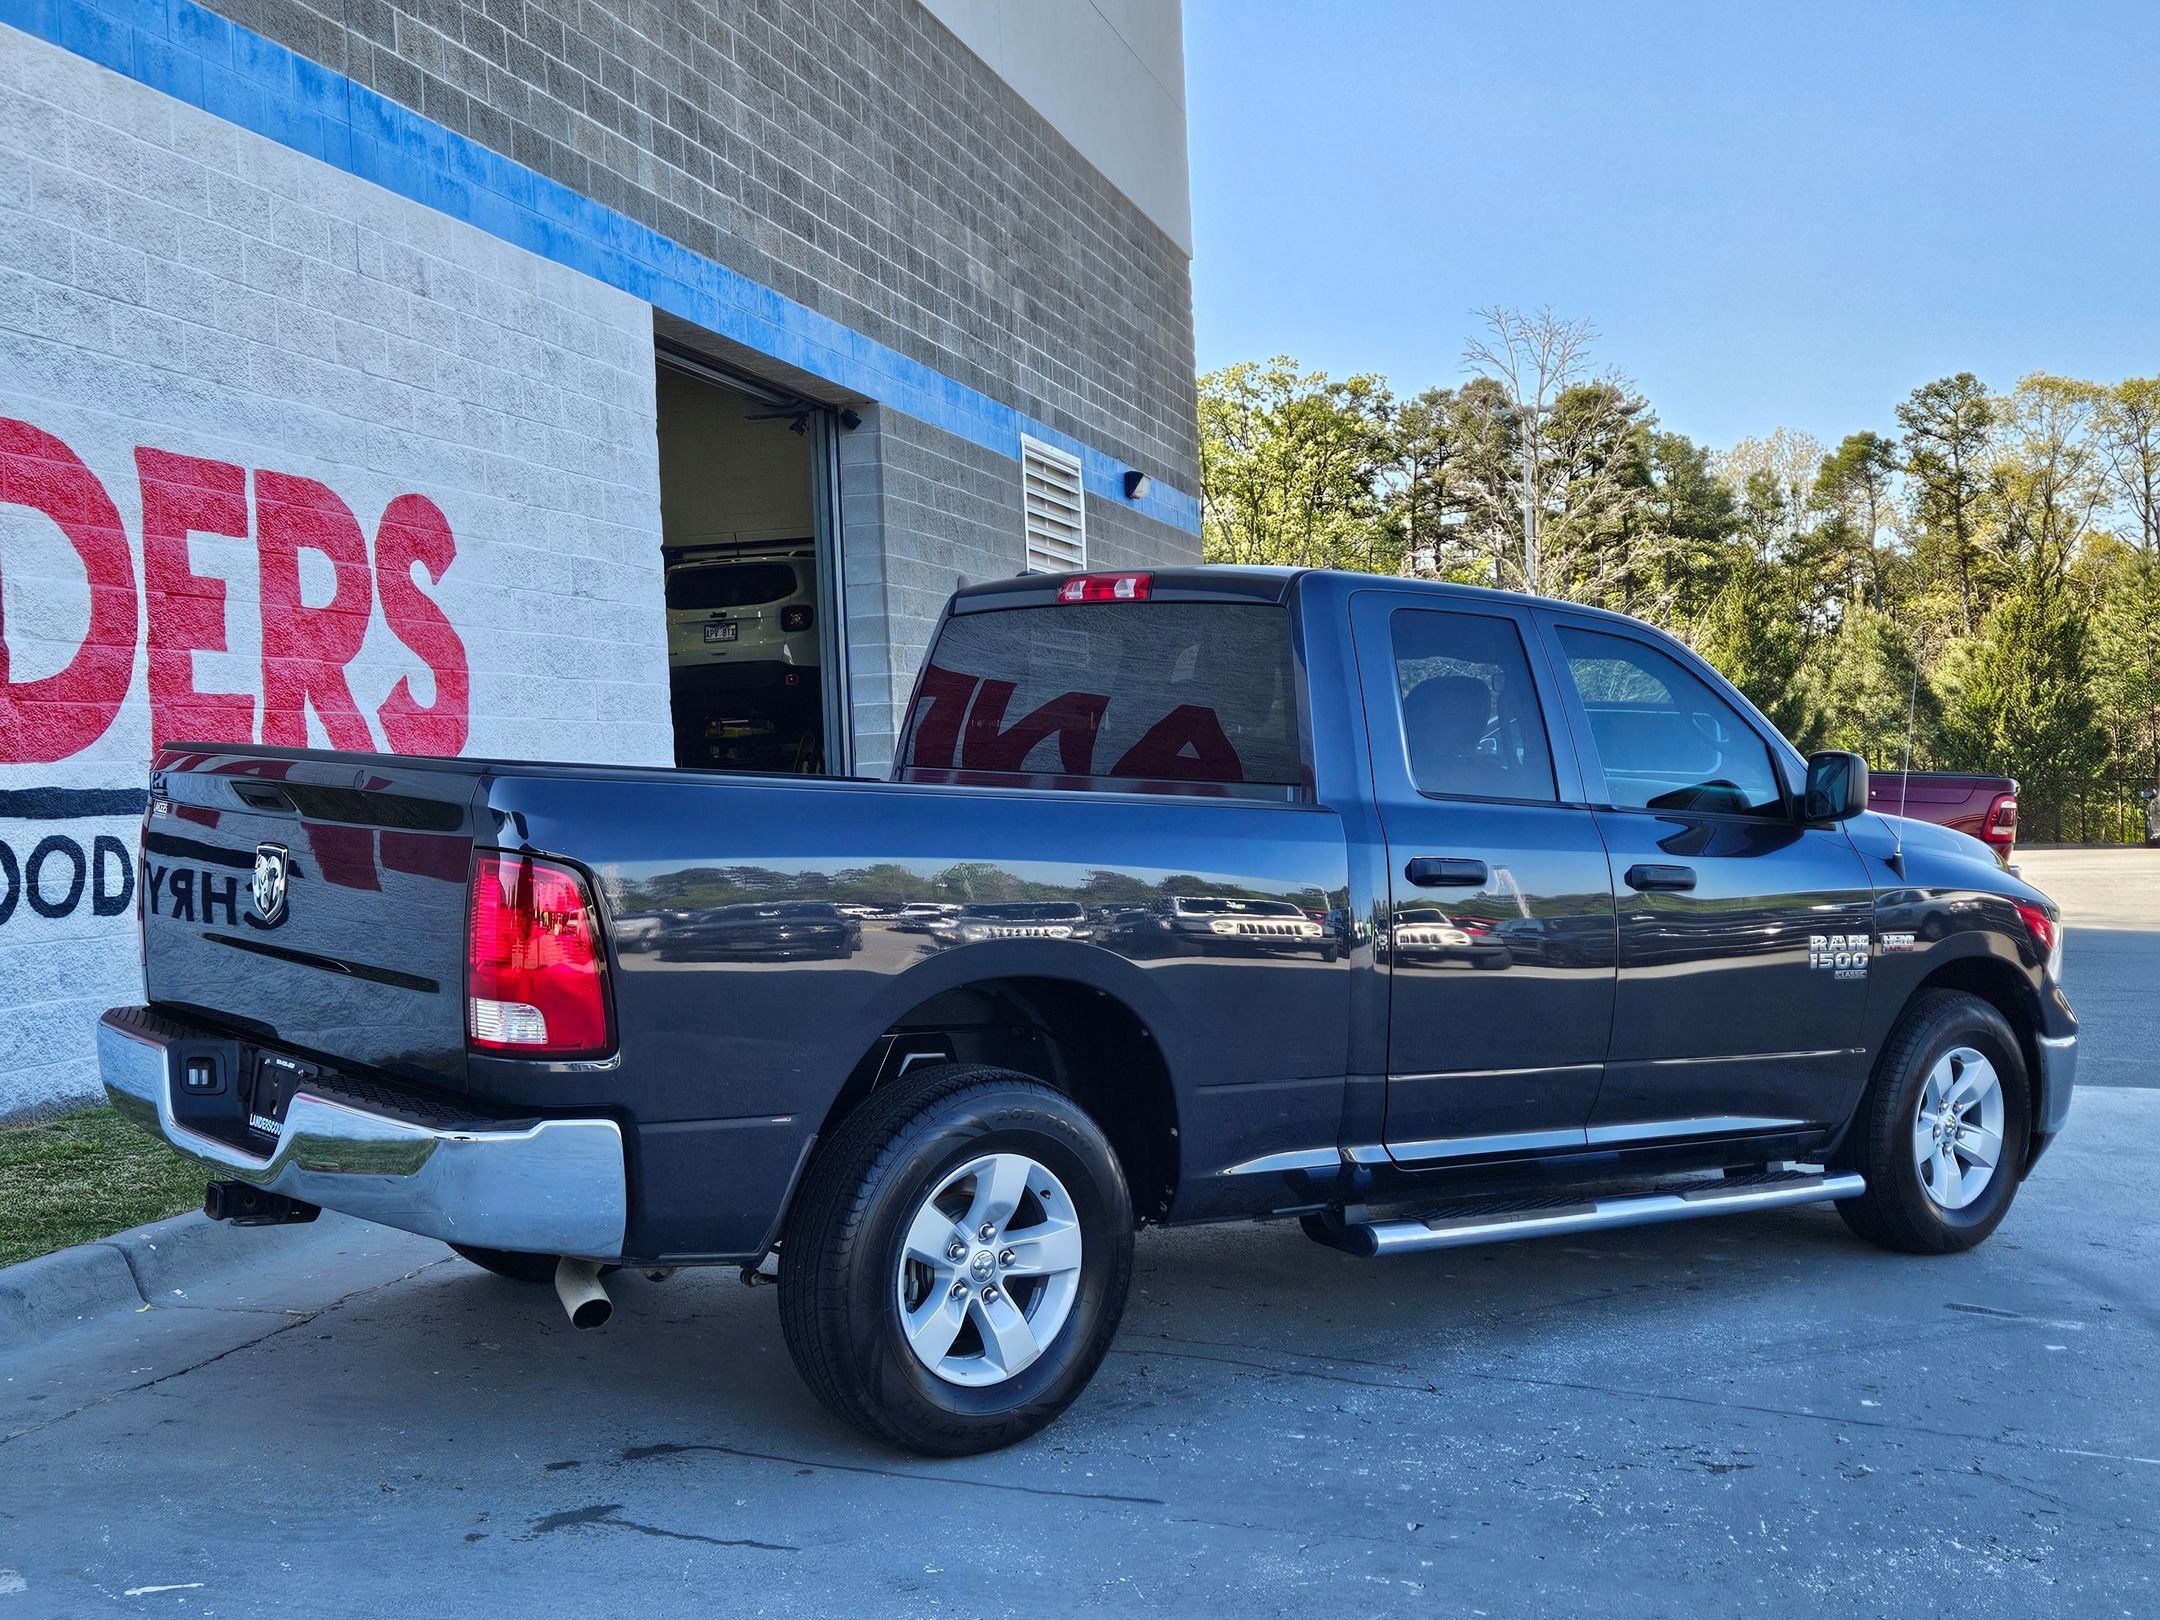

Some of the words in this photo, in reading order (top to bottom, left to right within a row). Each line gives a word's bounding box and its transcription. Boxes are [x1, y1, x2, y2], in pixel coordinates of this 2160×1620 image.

[0, 417, 469, 763] DERS
[1808, 934, 1870, 951] RAM
[1809, 952, 1869, 969] 1500
